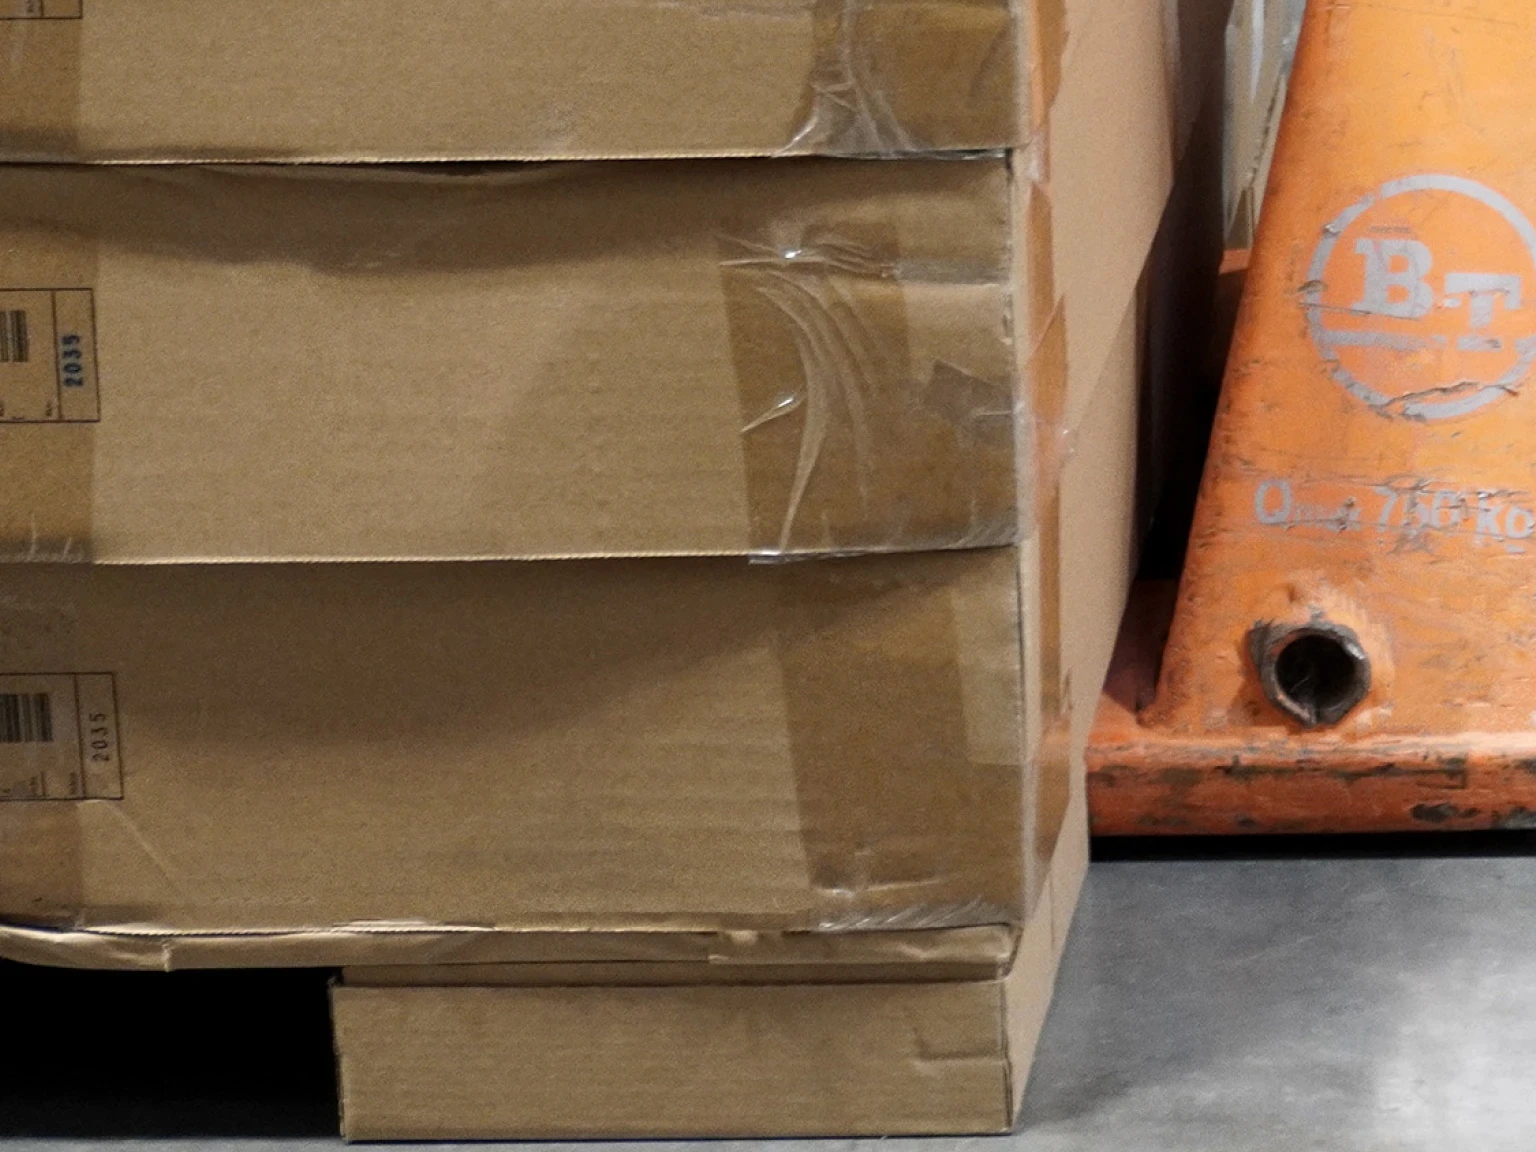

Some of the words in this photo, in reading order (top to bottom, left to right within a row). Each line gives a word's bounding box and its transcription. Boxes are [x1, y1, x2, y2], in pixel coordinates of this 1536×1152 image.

[1351, 238, 1521, 351] BT
[61, 334, 83, 387] 2035
[89, 713, 110, 761] 2035
